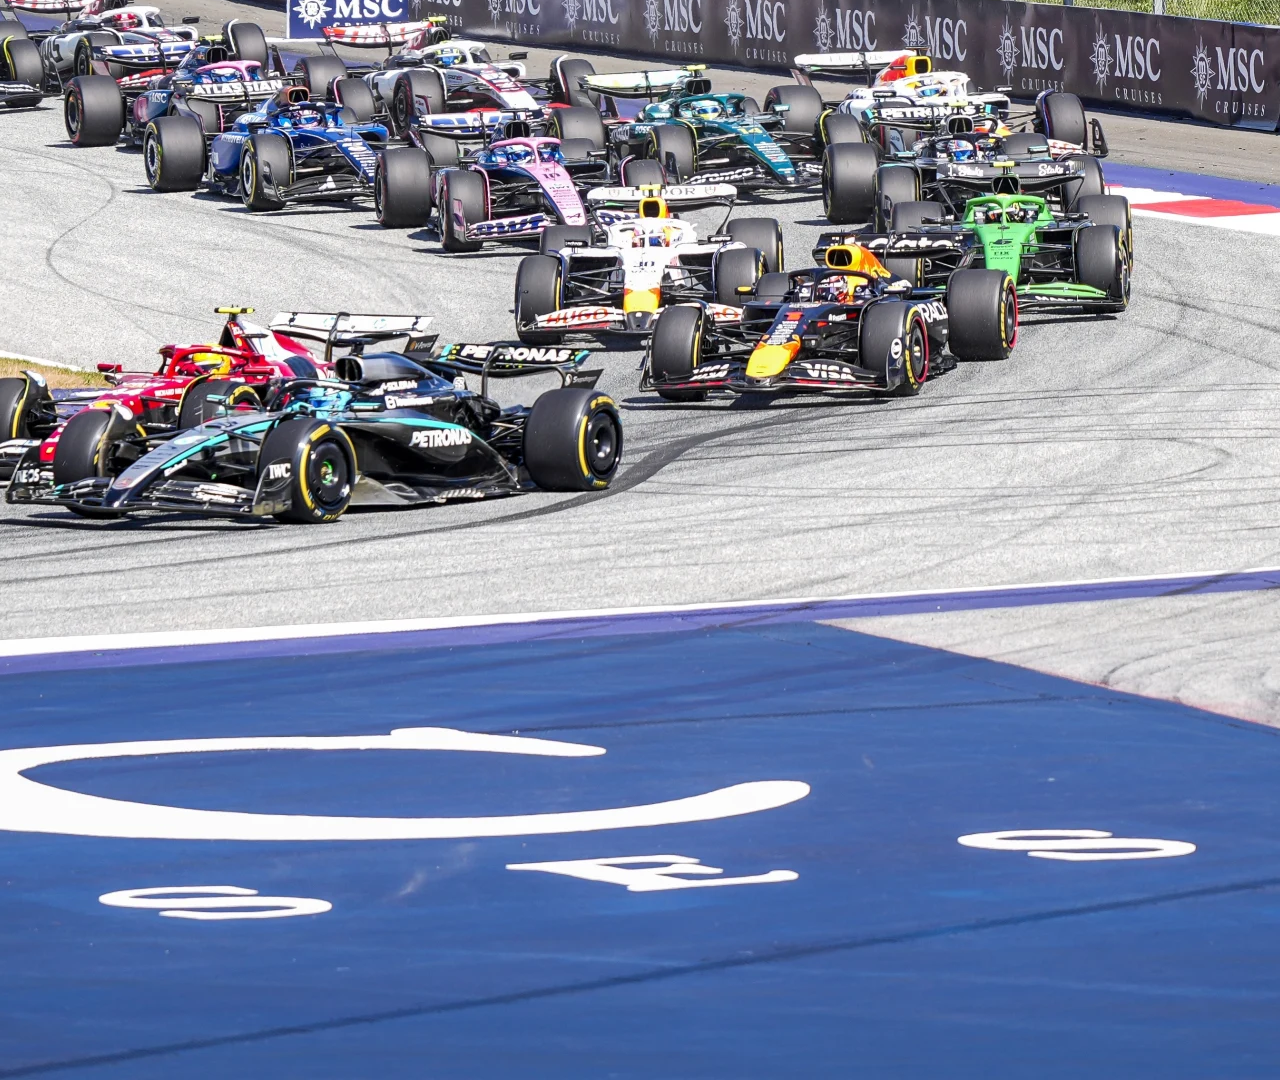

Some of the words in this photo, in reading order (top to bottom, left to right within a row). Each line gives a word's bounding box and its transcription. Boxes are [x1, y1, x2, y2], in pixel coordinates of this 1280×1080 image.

[582, 29, 620, 45] CRUISES
[836, 8, 878, 51] MSC
[926, 16, 967, 62] MSC
[665, 41, 704, 55] CRUISES
[746, 48, 787, 63] CRUISES
[1021, 26, 1064, 71] MSC
[1114, 34, 1161, 81] MSC
[1215, 46, 1265, 93] MSC
[194, 79, 282, 94] ATLASSIAN
[1021, 78, 1065, 93] CRUISES
[1115, 87, 1163, 105] CRUISES
[1216, 100, 1266, 117] CRUISES
[688, 168, 754, 185] aramco
[1038, 163, 1063, 176] Stake
[546, 307, 610, 324] HUGO
[461, 344, 571, 362] PERONAS
[803, 363, 857, 381] VISA
[411, 430, 473, 448] PETRONAS
[269, 464, 291, 479] IWC
